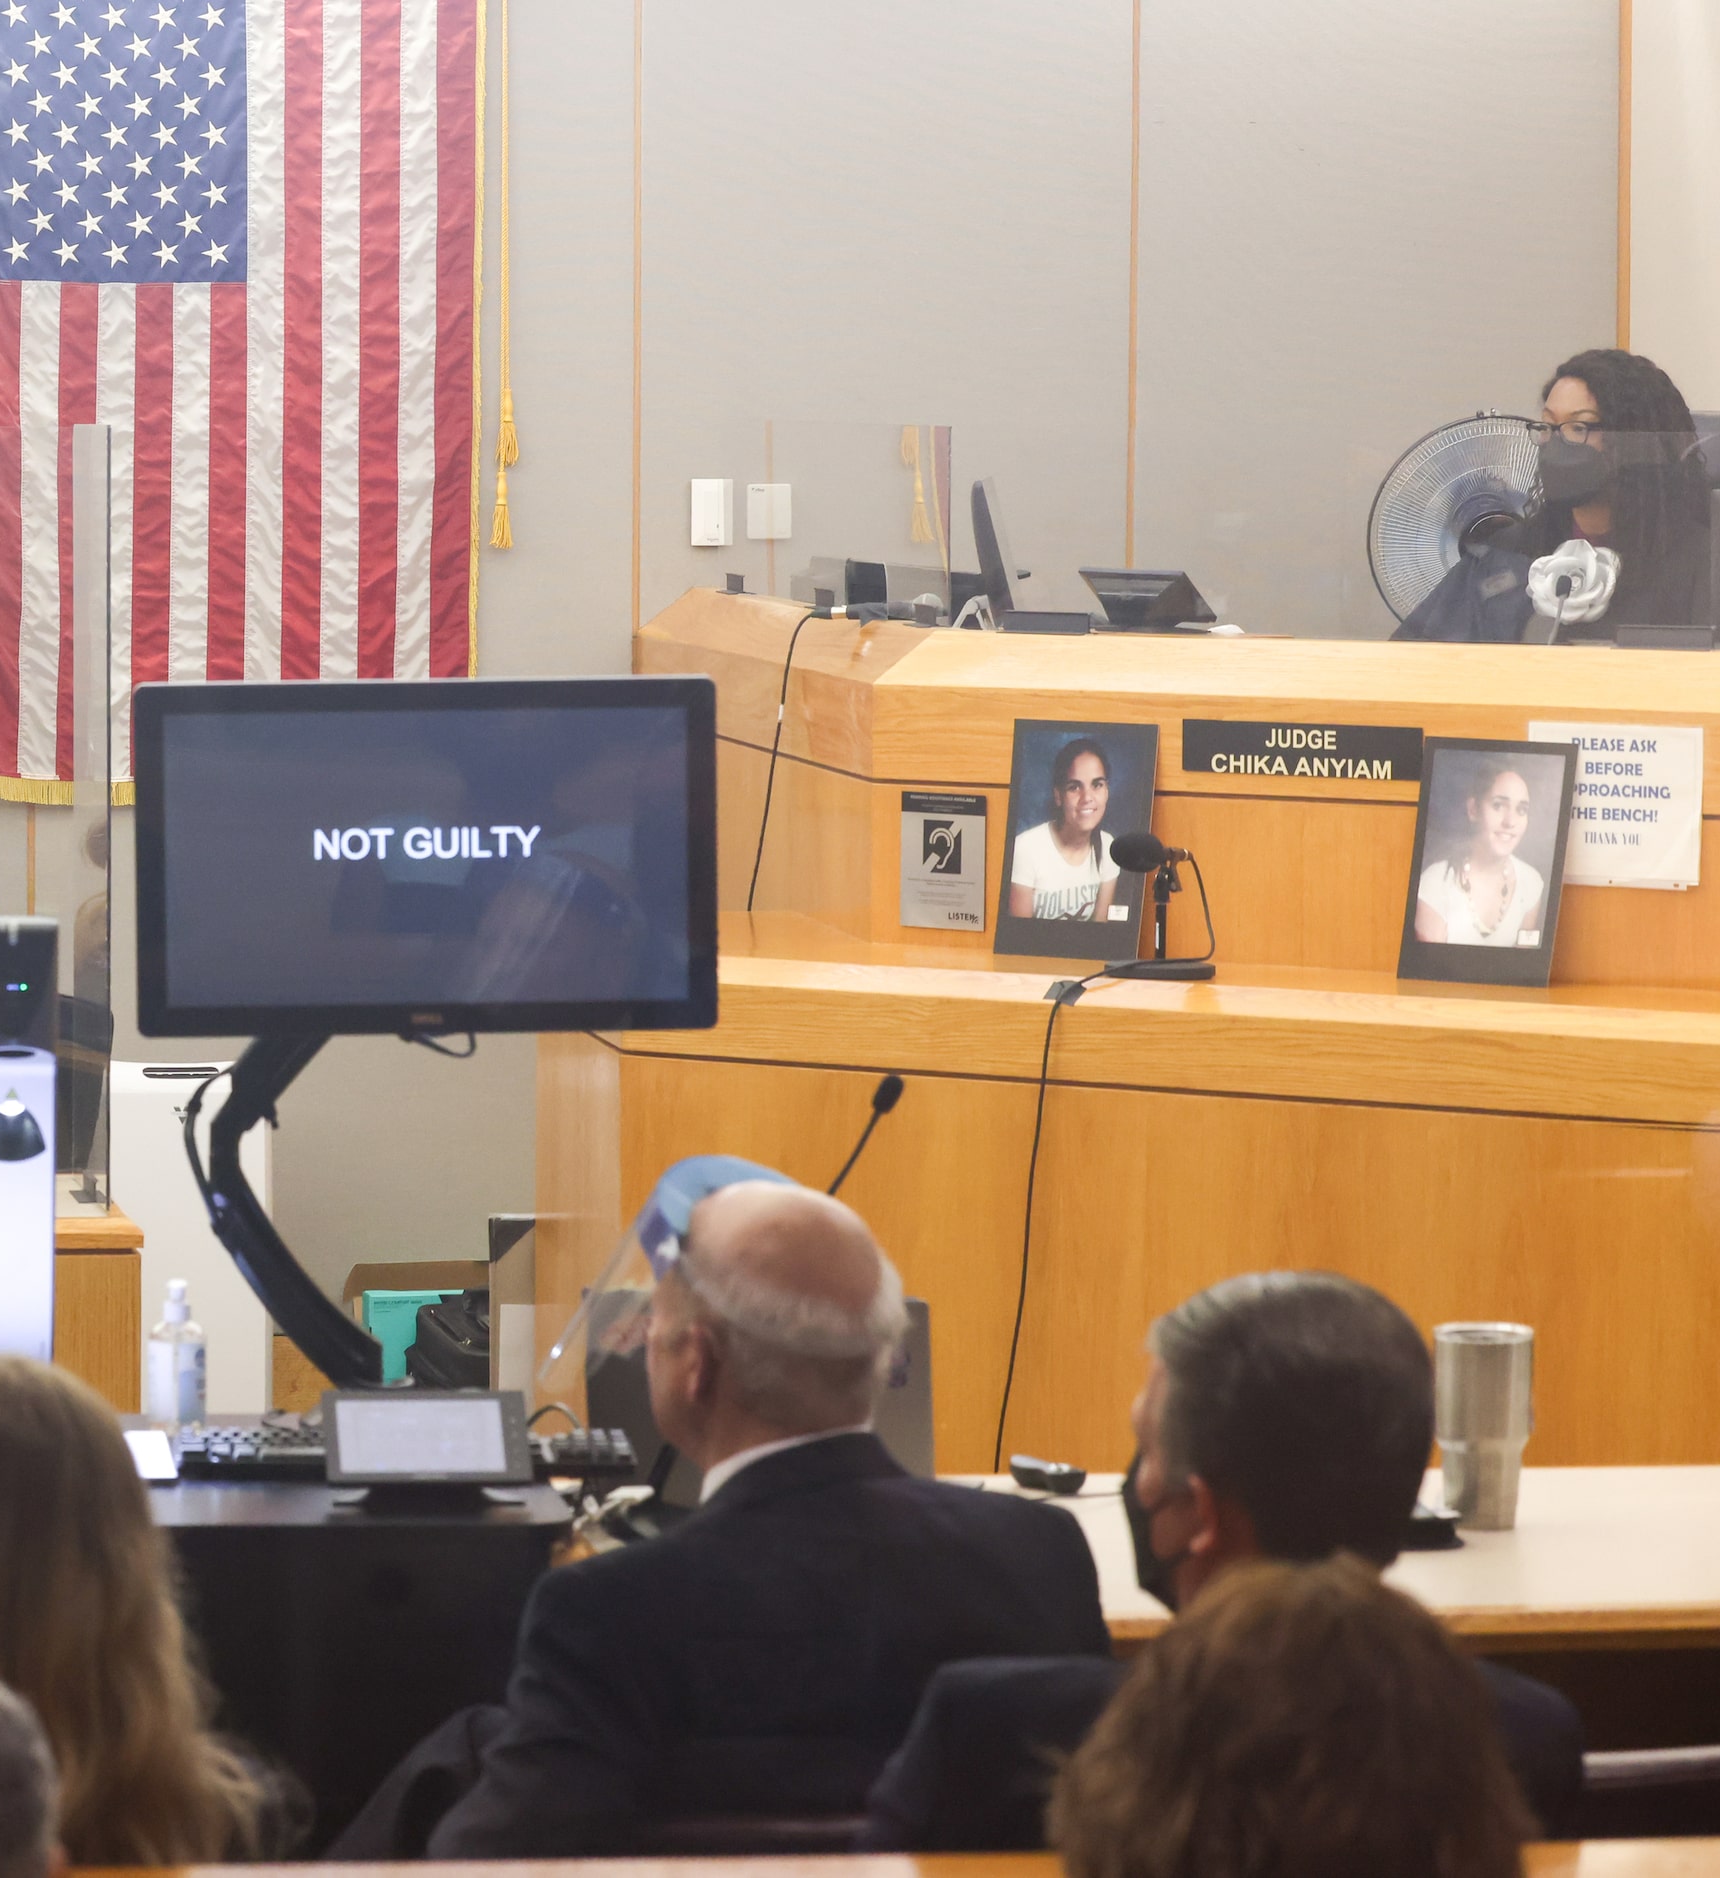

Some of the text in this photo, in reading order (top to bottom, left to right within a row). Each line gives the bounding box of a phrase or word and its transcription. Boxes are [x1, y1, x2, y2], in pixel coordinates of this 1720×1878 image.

[1265, 728, 1337, 750] JUDGE
[1629, 739, 1657, 753] ASK
[1210, 753, 1392, 780] CHIKA ANYIAM
[1585, 762, 1643, 776] BEFORE
[1570, 807, 1658, 823] THE BENCH!
[313, 825, 541, 861] NOT GUILTY
[1583, 831, 1642, 846] THANK YOU
[948, 912, 975, 921] LISTEN
